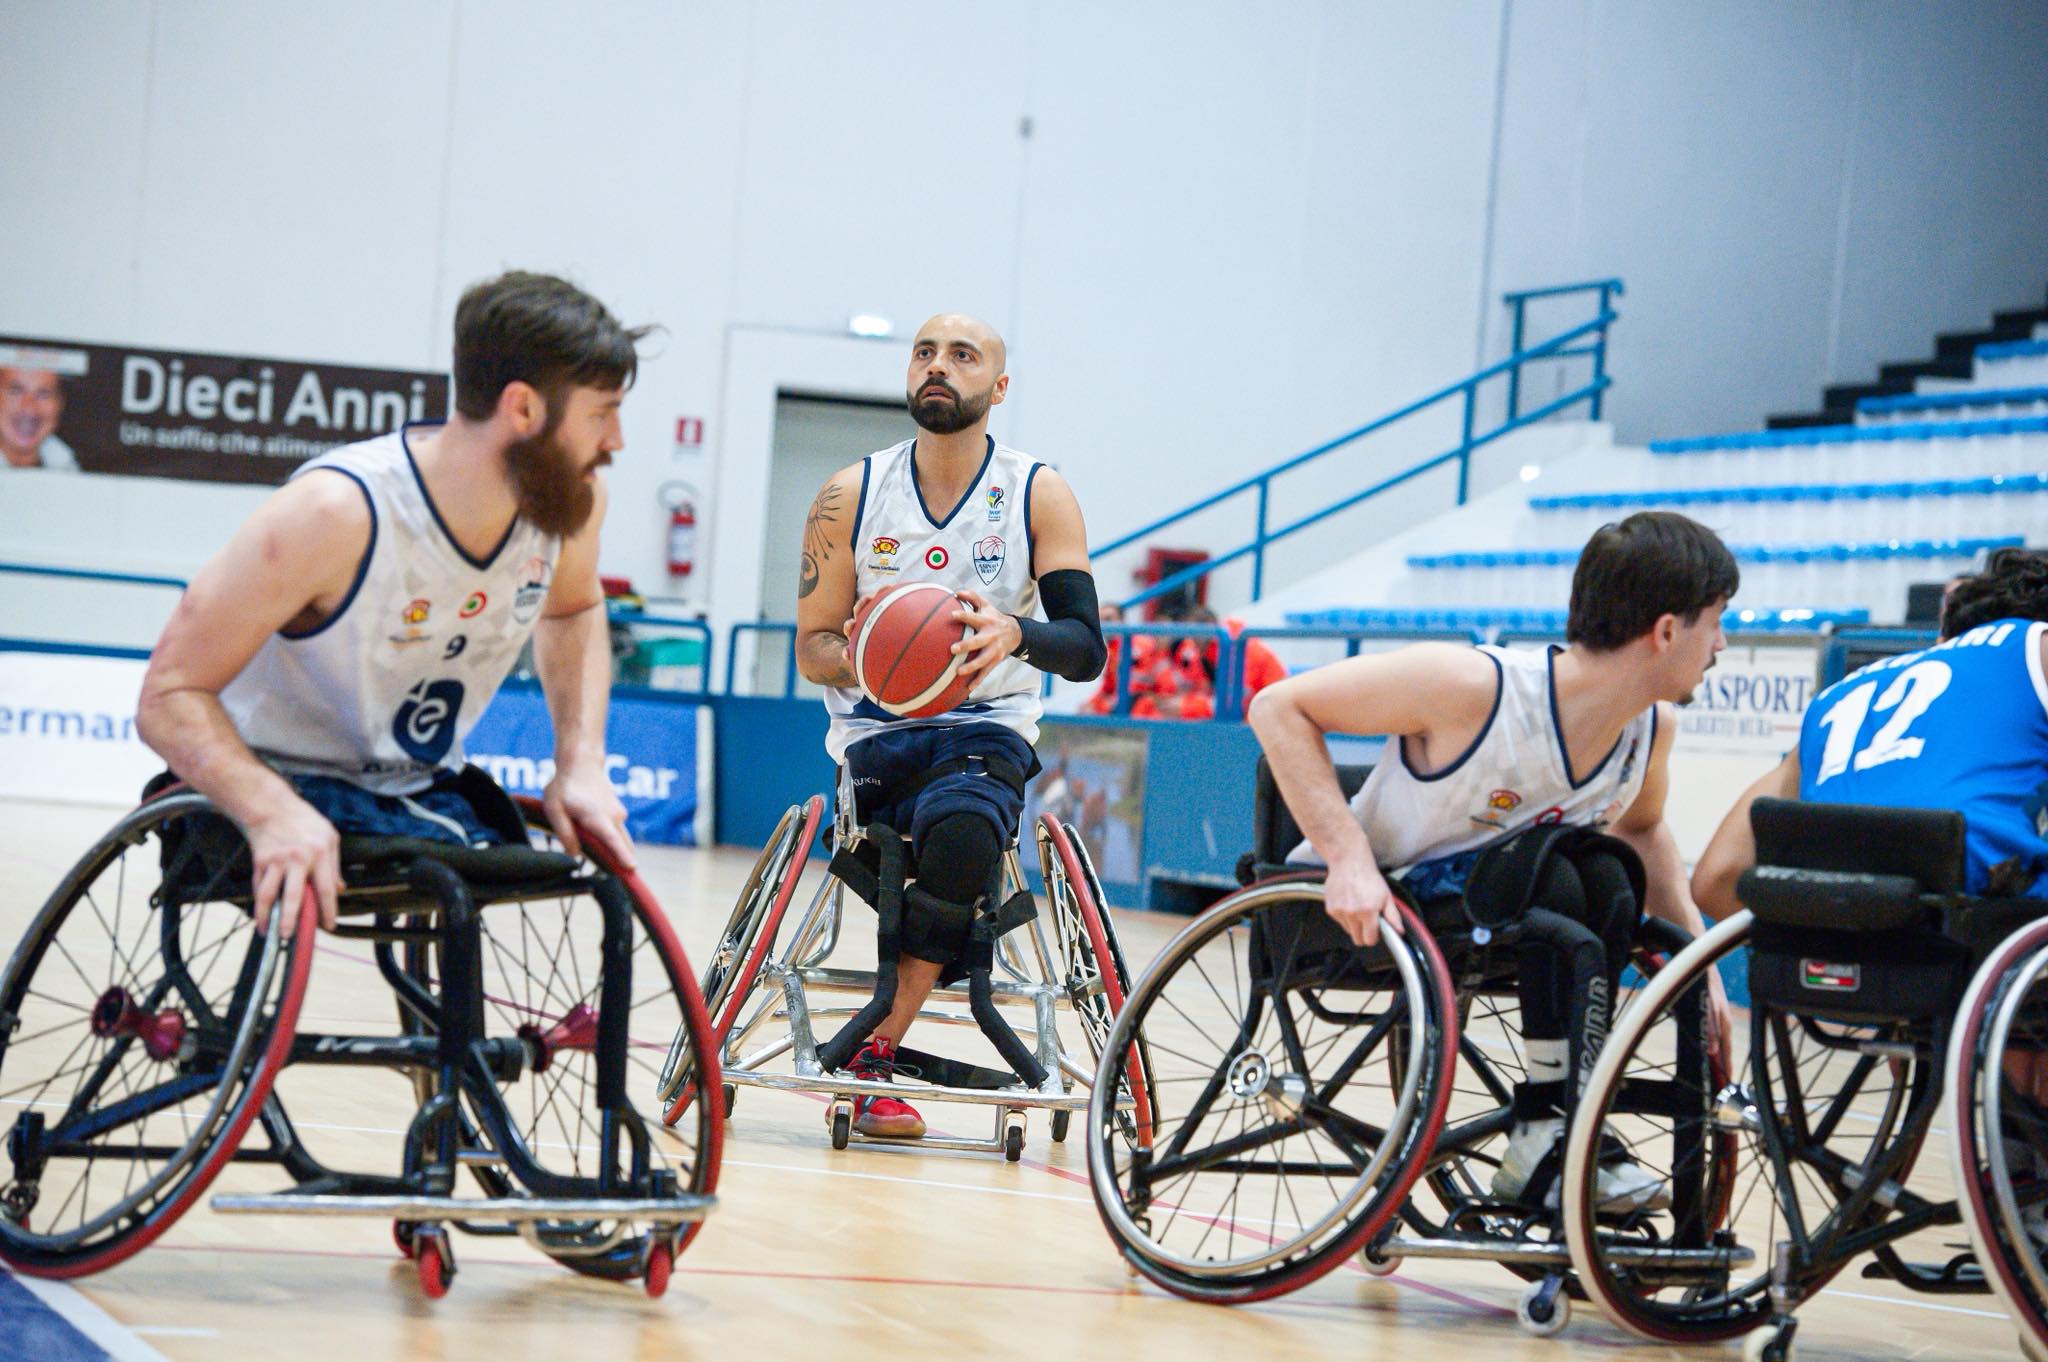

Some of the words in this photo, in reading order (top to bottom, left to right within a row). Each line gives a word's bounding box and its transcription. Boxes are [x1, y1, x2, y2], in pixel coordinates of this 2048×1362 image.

[120, 354, 275, 424] Dieci
[283, 370, 427, 432] Anni
[119, 421, 150, 445] Un
[441, 634, 467, 660] 9
[1815, 659, 1952, 786] 12
[604, 753, 678, 799] Car
